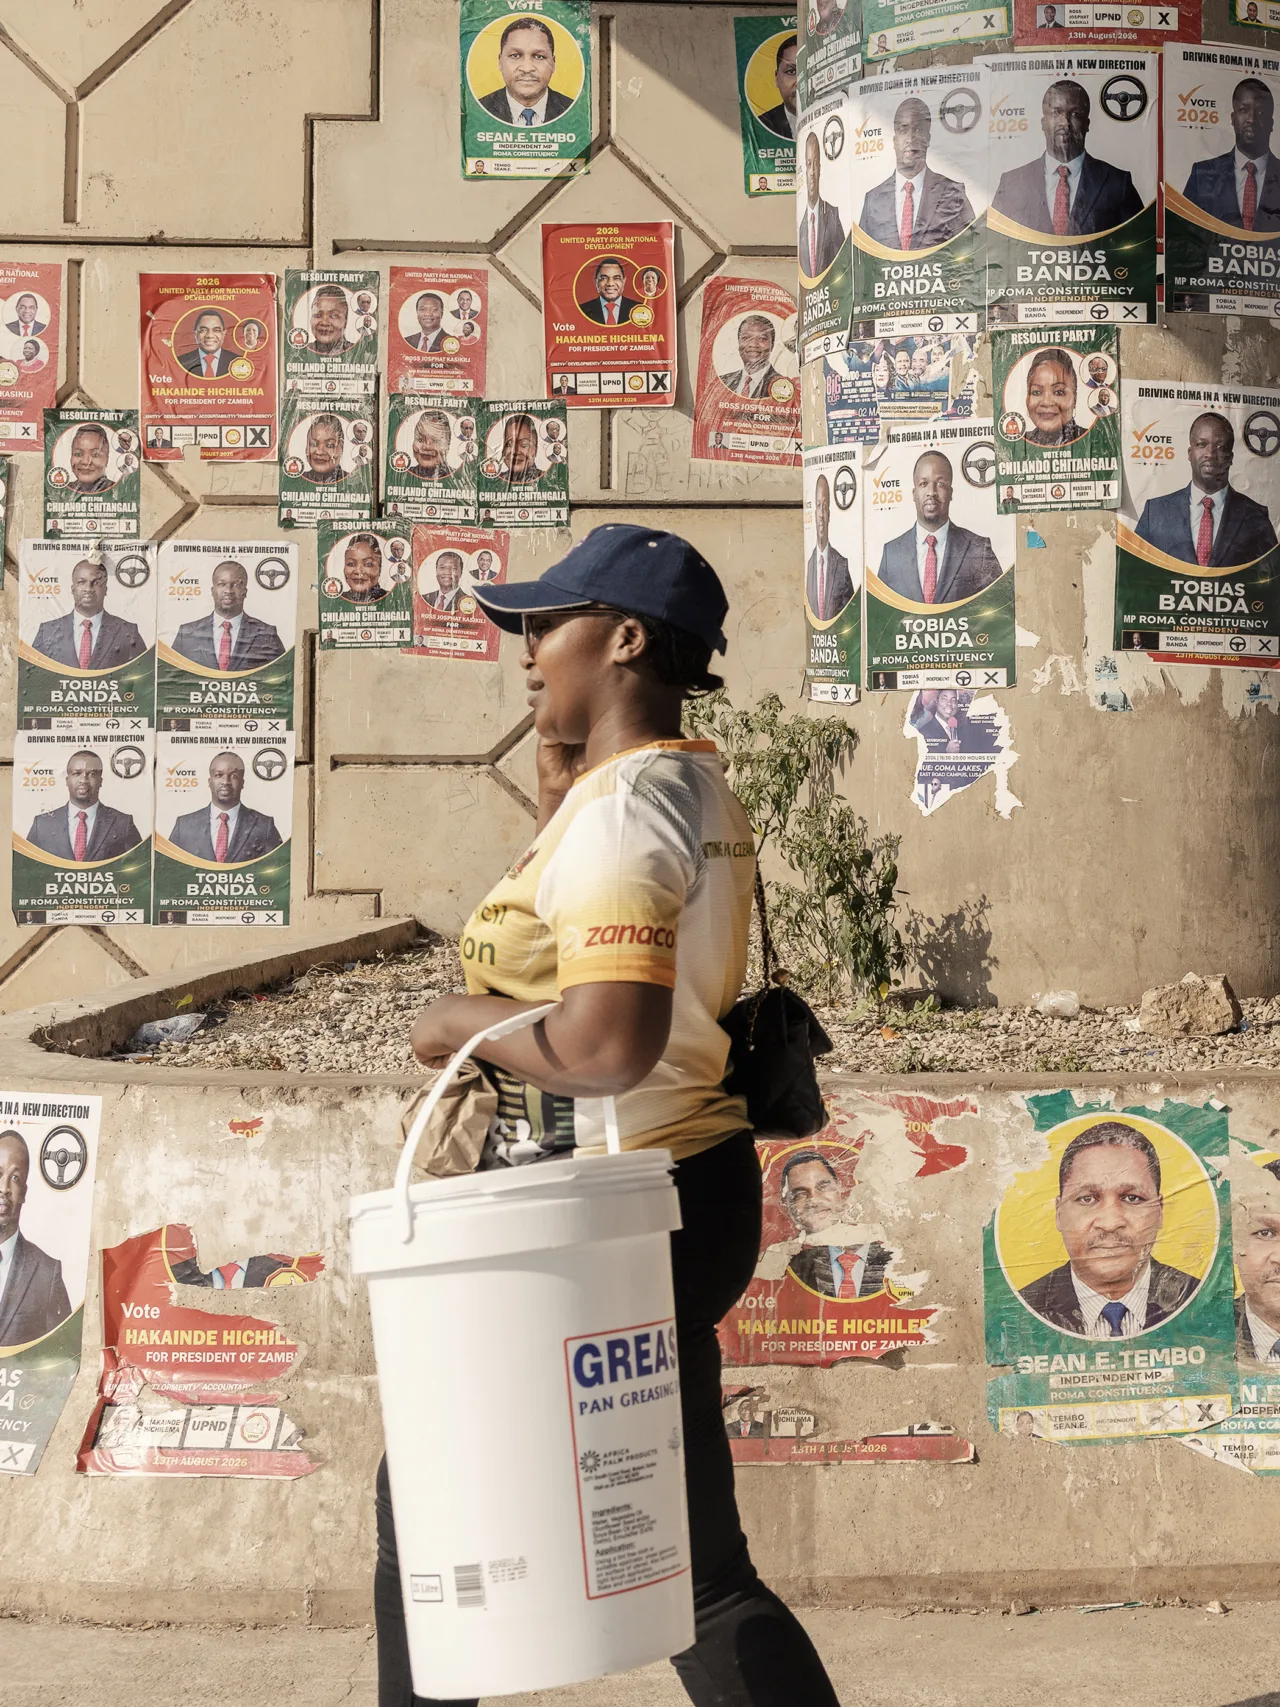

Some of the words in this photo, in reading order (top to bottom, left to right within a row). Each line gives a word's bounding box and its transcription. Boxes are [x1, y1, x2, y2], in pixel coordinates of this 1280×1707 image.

[1095, 12, 1122, 22] UPND
[1088, 32, 1116, 41] August
[1117, 32, 1138, 40] 2026
[476, 132, 513, 143] SEAN
[530, 132, 576, 144] TEMBO
[596, 227, 619, 235] 2026
[1028, 250, 1106, 264] TOBIAS
[881, 262, 942, 281] TOBIAS
[1016, 265, 1112, 283] BANDA
[874, 277, 947, 299] BANDA
[552, 322, 575, 332] Vote
[556, 335, 607, 345] HAKAINDE
[609, 334, 665, 344] HICHILEMA
[1011, 330, 1061, 345] RESOLUTE
[1062, 329, 1097, 343] PARTY
[151, 387, 205, 397] HAKAINDE
[207, 387, 265, 396] HICHILEMA
[1138, 387, 1175, 400] DRIVING
[1176, 388, 1201, 400] ROMA
[1203, 390, 1212, 401] IN
[1213, 390, 1220, 402] A
[1222, 391, 1241, 404] NEW
[1145, 434, 1173, 444] VOTE
[1130, 444, 1175, 460] 2026
[999, 460, 1050, 476] CHILANDO
[1051, 457, 1119, 473] CHITANGALA
[168, 586, 202, 597] 2026
[1170, 579, 1246, 597] TOBIAS
[1158, 594, 1249, 614] BANDA
[321, 611, 362, 623] CHILANDO
[362, 610, 411, 622] CHITANGALA
[1123, 613, 1137, 624] MP
[1139, 614, 1176, 625] ROMA
[1179, 615, 1269, 630] CONSTITUENCY
[903, 616, 969, 633] TOBIAS
[1172, 624, 1240, 635] INDEPENDENT
[895, 630, 974, 651] BANDA
[199, 681, 258, 692] TOBIAS
[189, 692, 260, 704] BANDA
[54, 871, 114, 883] TOBIAS
[45, 882, 118, 895] BANDA
[584, 924, 676, 949] zanaco
[22, 1102, 40, 1115] NEW
[42, 1103, 90, 1119] DIRECTION
[120, 1302, 160, 1319] Vote
[125, 1329, 217, 1346] HAKAINDE
[761, 1341, 786, 1352] FOR
[789, 1340, 858, 1352] PRESIDENT
[860, 1340, 877, 1351] OF
[1118, 1345, 1206, 1369] TEMBO
[1051, 1391, 1086, 1402] ROMA
[1088, 1385, 1175, 1400] CONSTITUENCY
[579, 1395, 614, 1416] PAN
[1053, 1414, 1085, 1422] TEMBO
[191, 1420, 228, 1432] UPND
[1221, 1421, 1256, 1431] ROMA
[152, 1455, 179, 1466] 13TH
[180, 1456, 219, 1467] AUGUST
[221, 1457, 248, 1467] 2026
